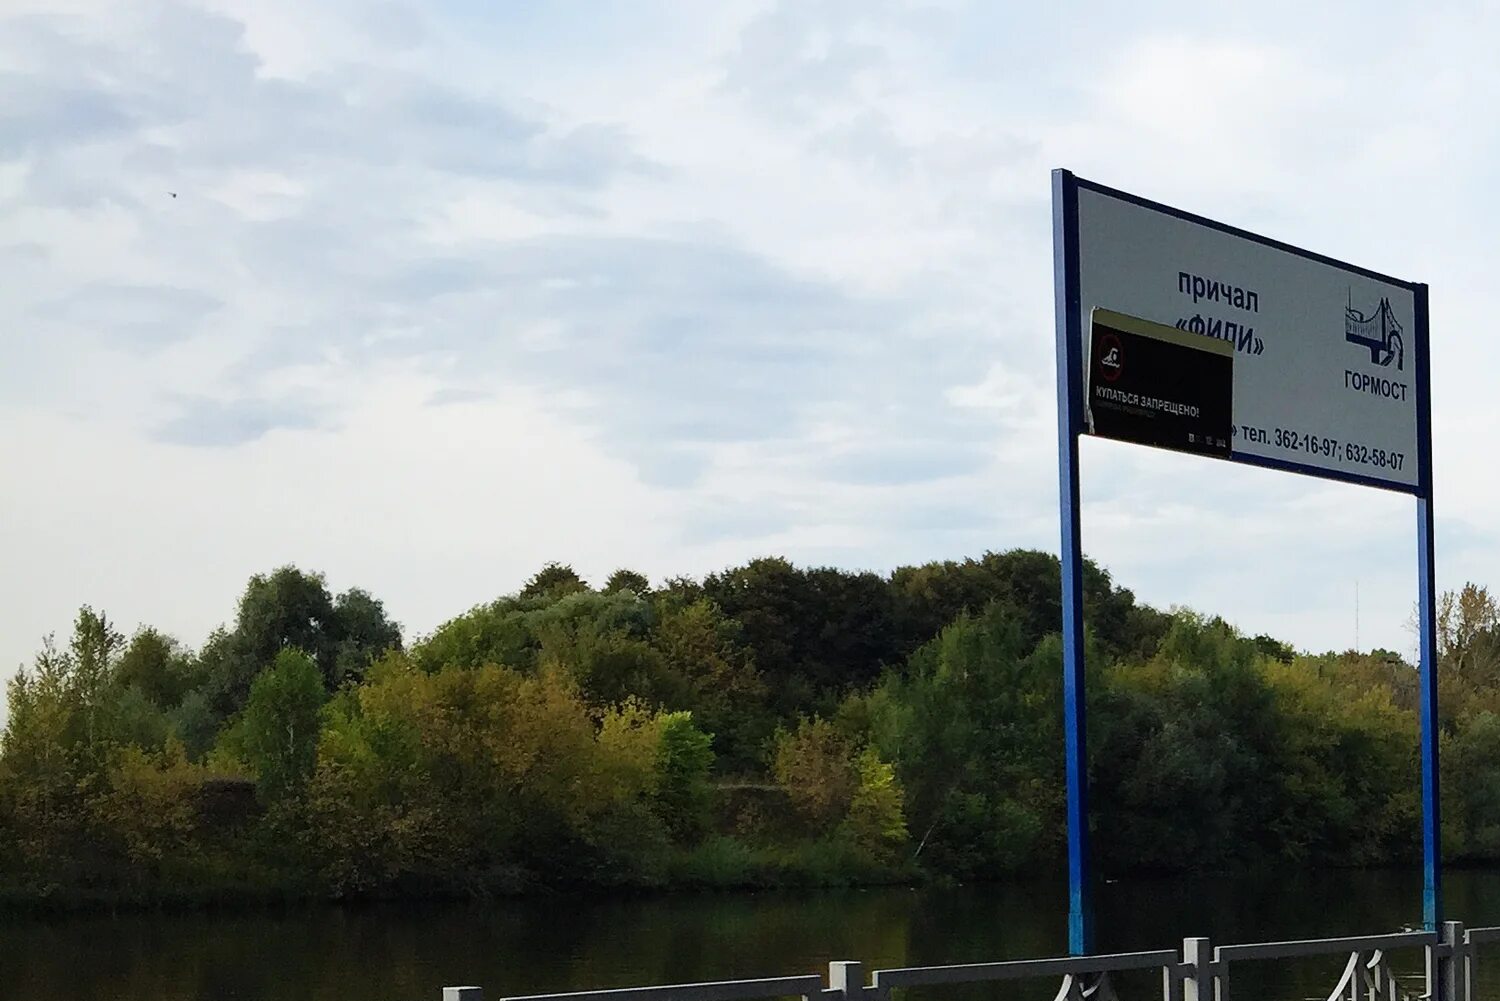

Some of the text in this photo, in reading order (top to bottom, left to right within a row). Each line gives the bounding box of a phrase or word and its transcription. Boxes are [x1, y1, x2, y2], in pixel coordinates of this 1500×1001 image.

[1179, 272, 1258, 312] причал
[1096, 385, 1139, 405] КУПАТЬСЯ
[1140, 396, 1200, 418] ЗАПРЕЩЕНО!
[1344, 369, 1407, 401] ГОРМОСТ
[1241, 425, 1270, 445] тел.
[1275, 428, 1342, 461] 362-16-97;
[1346, 443, 1404, 471] 632-58-07
